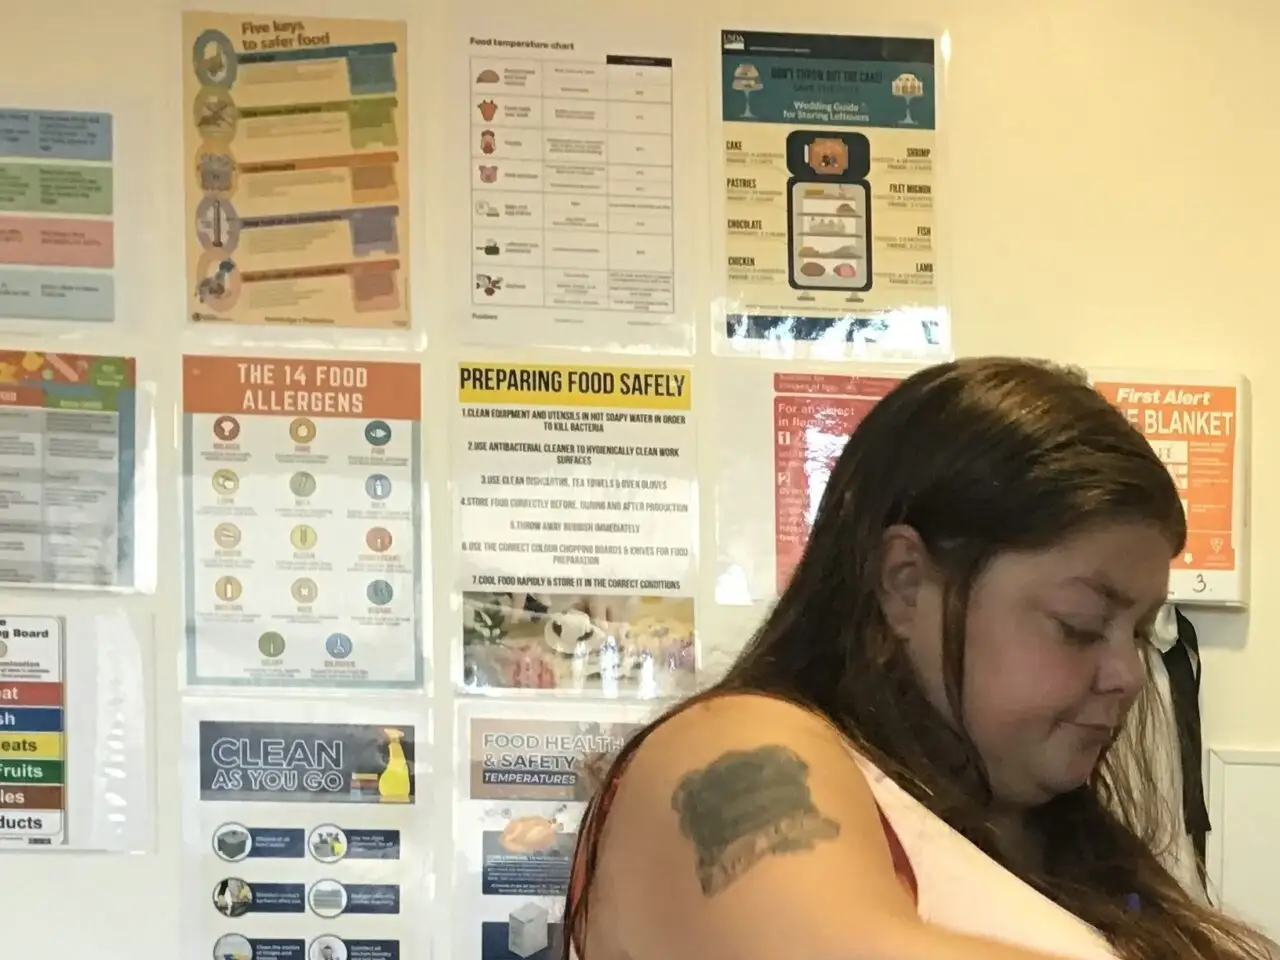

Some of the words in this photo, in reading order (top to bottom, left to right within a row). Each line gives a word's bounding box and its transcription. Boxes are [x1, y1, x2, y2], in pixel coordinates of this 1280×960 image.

[241, 22, 270, 34] Five
[272, 20, 305, 33] keys
[242, 40, 257, 50] to
[260, 36, 293, 49] safer
[297, 32, 330, 46] food
[470, 37, 492, 46] Food
[494, 39, 549, 49] temperature
[551, 42, 574, 50] chart
[793, 100, 832, 112] Wedding
[834, 102, 859, 112] Guide
[783, 110, 795, 118] for
[829, 111, 869, 122] Leftovers
[726, 141, 742, 151] CAKE
[906, 148, 930, 157] SHRIMP
[727, 178, 756, 189] PASTRIES
[889, 184, 905, 193] FILET
[728, 219, 762, 230] CHOCOLATE
[917, 226, 931, 236] FISH
[728, 256, 755, 267] CHICKEN
[915, 263, 933, 273] LAMB
[238, 363, 274, 384] THE
[284, 365, 306, 385] 14
[316, 366, 367, 387] FOOD
[460, 368, 562, 392] PREPARING
[568, 371, 614, 394] FOOD
[620, 373, 685, 397] SAFELY
[242, 389, 363, 413] ALLERGENS
[1116, 388, 1161, 404] First
[1163, 390, 1211, 406] Alert
[778, 403, 797, 413] For
[491, 409, 530, 419] EQUIPMENT
[532, 410, 546, 419] AND
[548, 411, 580, 420] UTENSILS
[582, 412, 589, 420] IN
[591, 412, 603, 421] HOT
[606, 412, 627, 422] SOAPY
[630, 413, 652, 423] WATER
[654, 414, 661, 423] IN
[663, 415, 685, 424] ORDER
[778, 417, 788, 426] in
[544, 421, 552, 430] TO
[554, 422, 568, 431] KILL
[571, 423, 604, 432] BACTERIA
[1144, 409, 1234, 437] BLANKET
[489, 442, 542, 453] ANTIBACTERIAL
[544, 444, 575, 454] CLEANER
[577, 445, 585, 454] TO
[586, 445, 634, 455] HYGIENICALLY
[636, 447, 657, 456] CLEAN
[659, 448, 679, 457] WORK
[557, 456, 591, 465] SURFACES
[502, 476, 524, 486] CLEAN
[572, 478, 585, 487] TEA
[641, 481, 667, 490] GLOVES
[607, 502, 621, 511] AND
[623, 502, 644, 511] AFTER
[646, 503, 688, 513] PRODUCTION
[595, 524, 640, 533] IMMEDIATELY
[484, 543, 496, 552] THE
[656, 548, 669, 556] FOR
[671, 548, 688, 557] FOOD
[553, 555, 599, 565] PREPARATION
[498, 577, 515, 586] FOOD
[517, 577, 545, 587] RAPIDLY
[553, 579, 575, 587] STORE
[576, 579, 582, 588] IT
[584, 580, 592, 588] IN
[594, 580, 607, 588] THE
[608, 580, 638, 589] CORRECT
[640, 581, 680, 590] CONDITIONS
[13, 629, 49, 640] Board
[1, 739, 37, 752] eats
[483, 734, 539, 750] FOOD
[544, 735, 625, 753] HEALTH
[211, 737, 343, 770] CLEAN
[484, 754, 495, 768] &
[501, 754, 575, 770] SAFETY
[212, 769, 242, 789] AS
[248, 770, 297, 791] YOU
[303, 771, 344, 791] GO
[484, 772, 576, 784] TEMPERATURES
